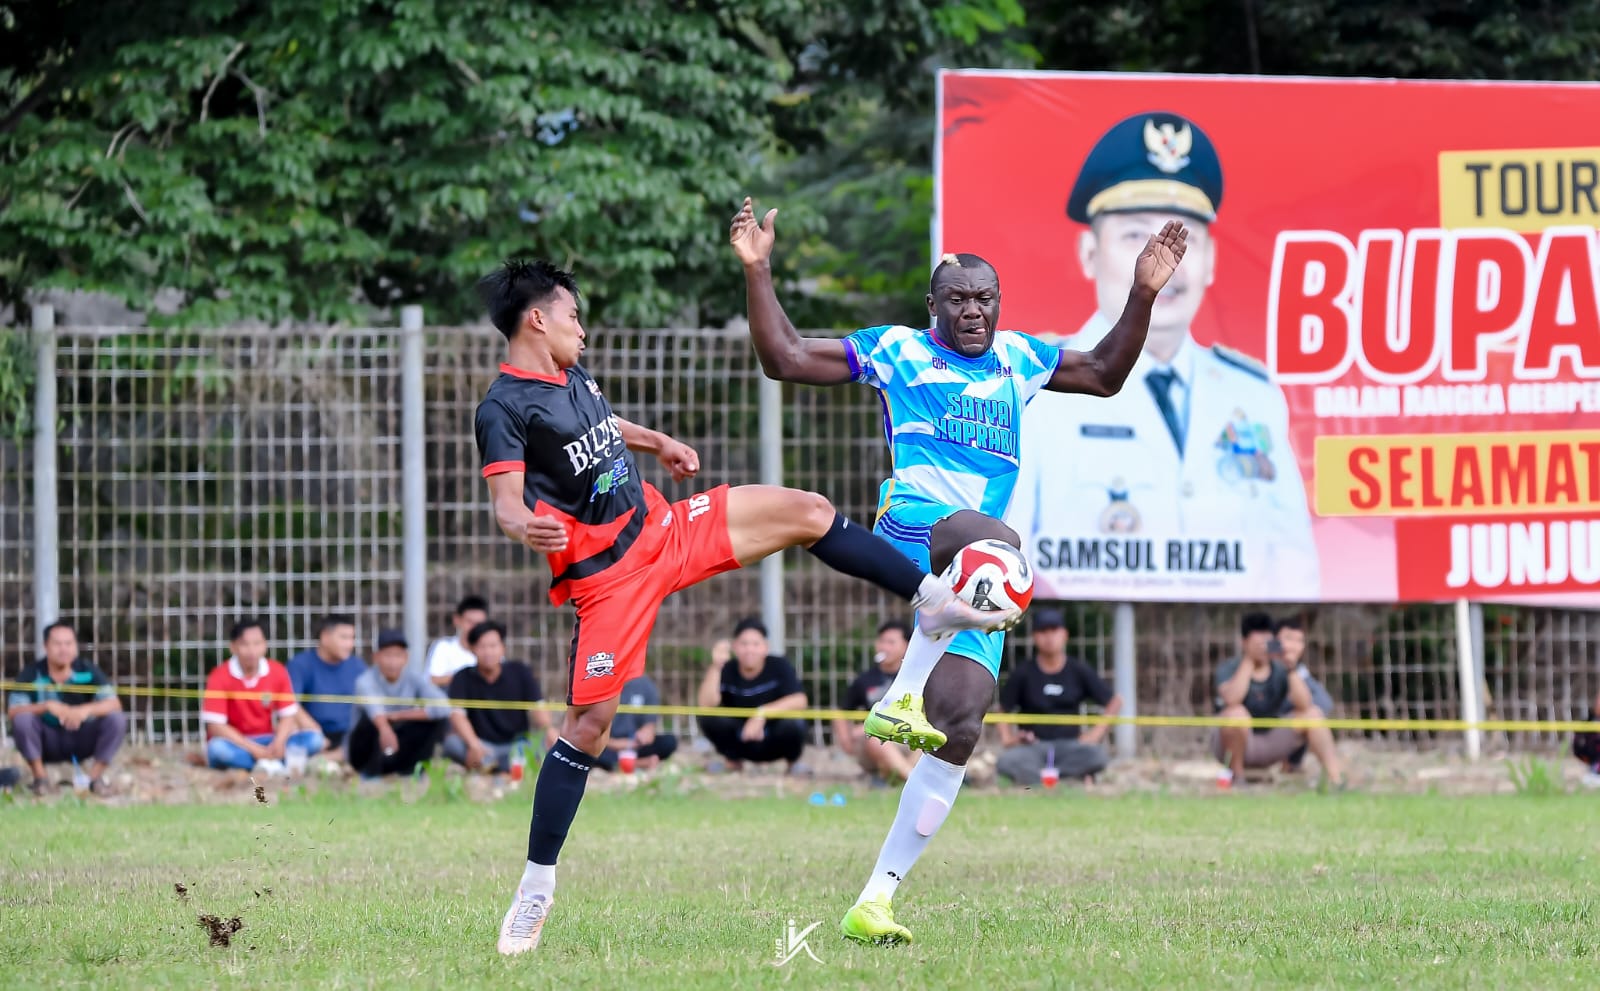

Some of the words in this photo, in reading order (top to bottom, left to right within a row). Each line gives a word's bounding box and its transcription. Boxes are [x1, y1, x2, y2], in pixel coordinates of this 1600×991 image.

[1464, 160, 1599, 217] TOUR
[1267, 226, 1600, 384] BUPA
[946, 392, 1010, 429] SATYA
[1314, 385, 1401, 418] DALAM
[1403, 382, 1506, 416] RANGKA
[1348, 443, 1600, 511] SELAMAT
[1037, 537, 1157, 573] SAMSUL
[1166, 539, 1247, 573] RIZAL
[1446, 519, 1600, 588] JUNJU
